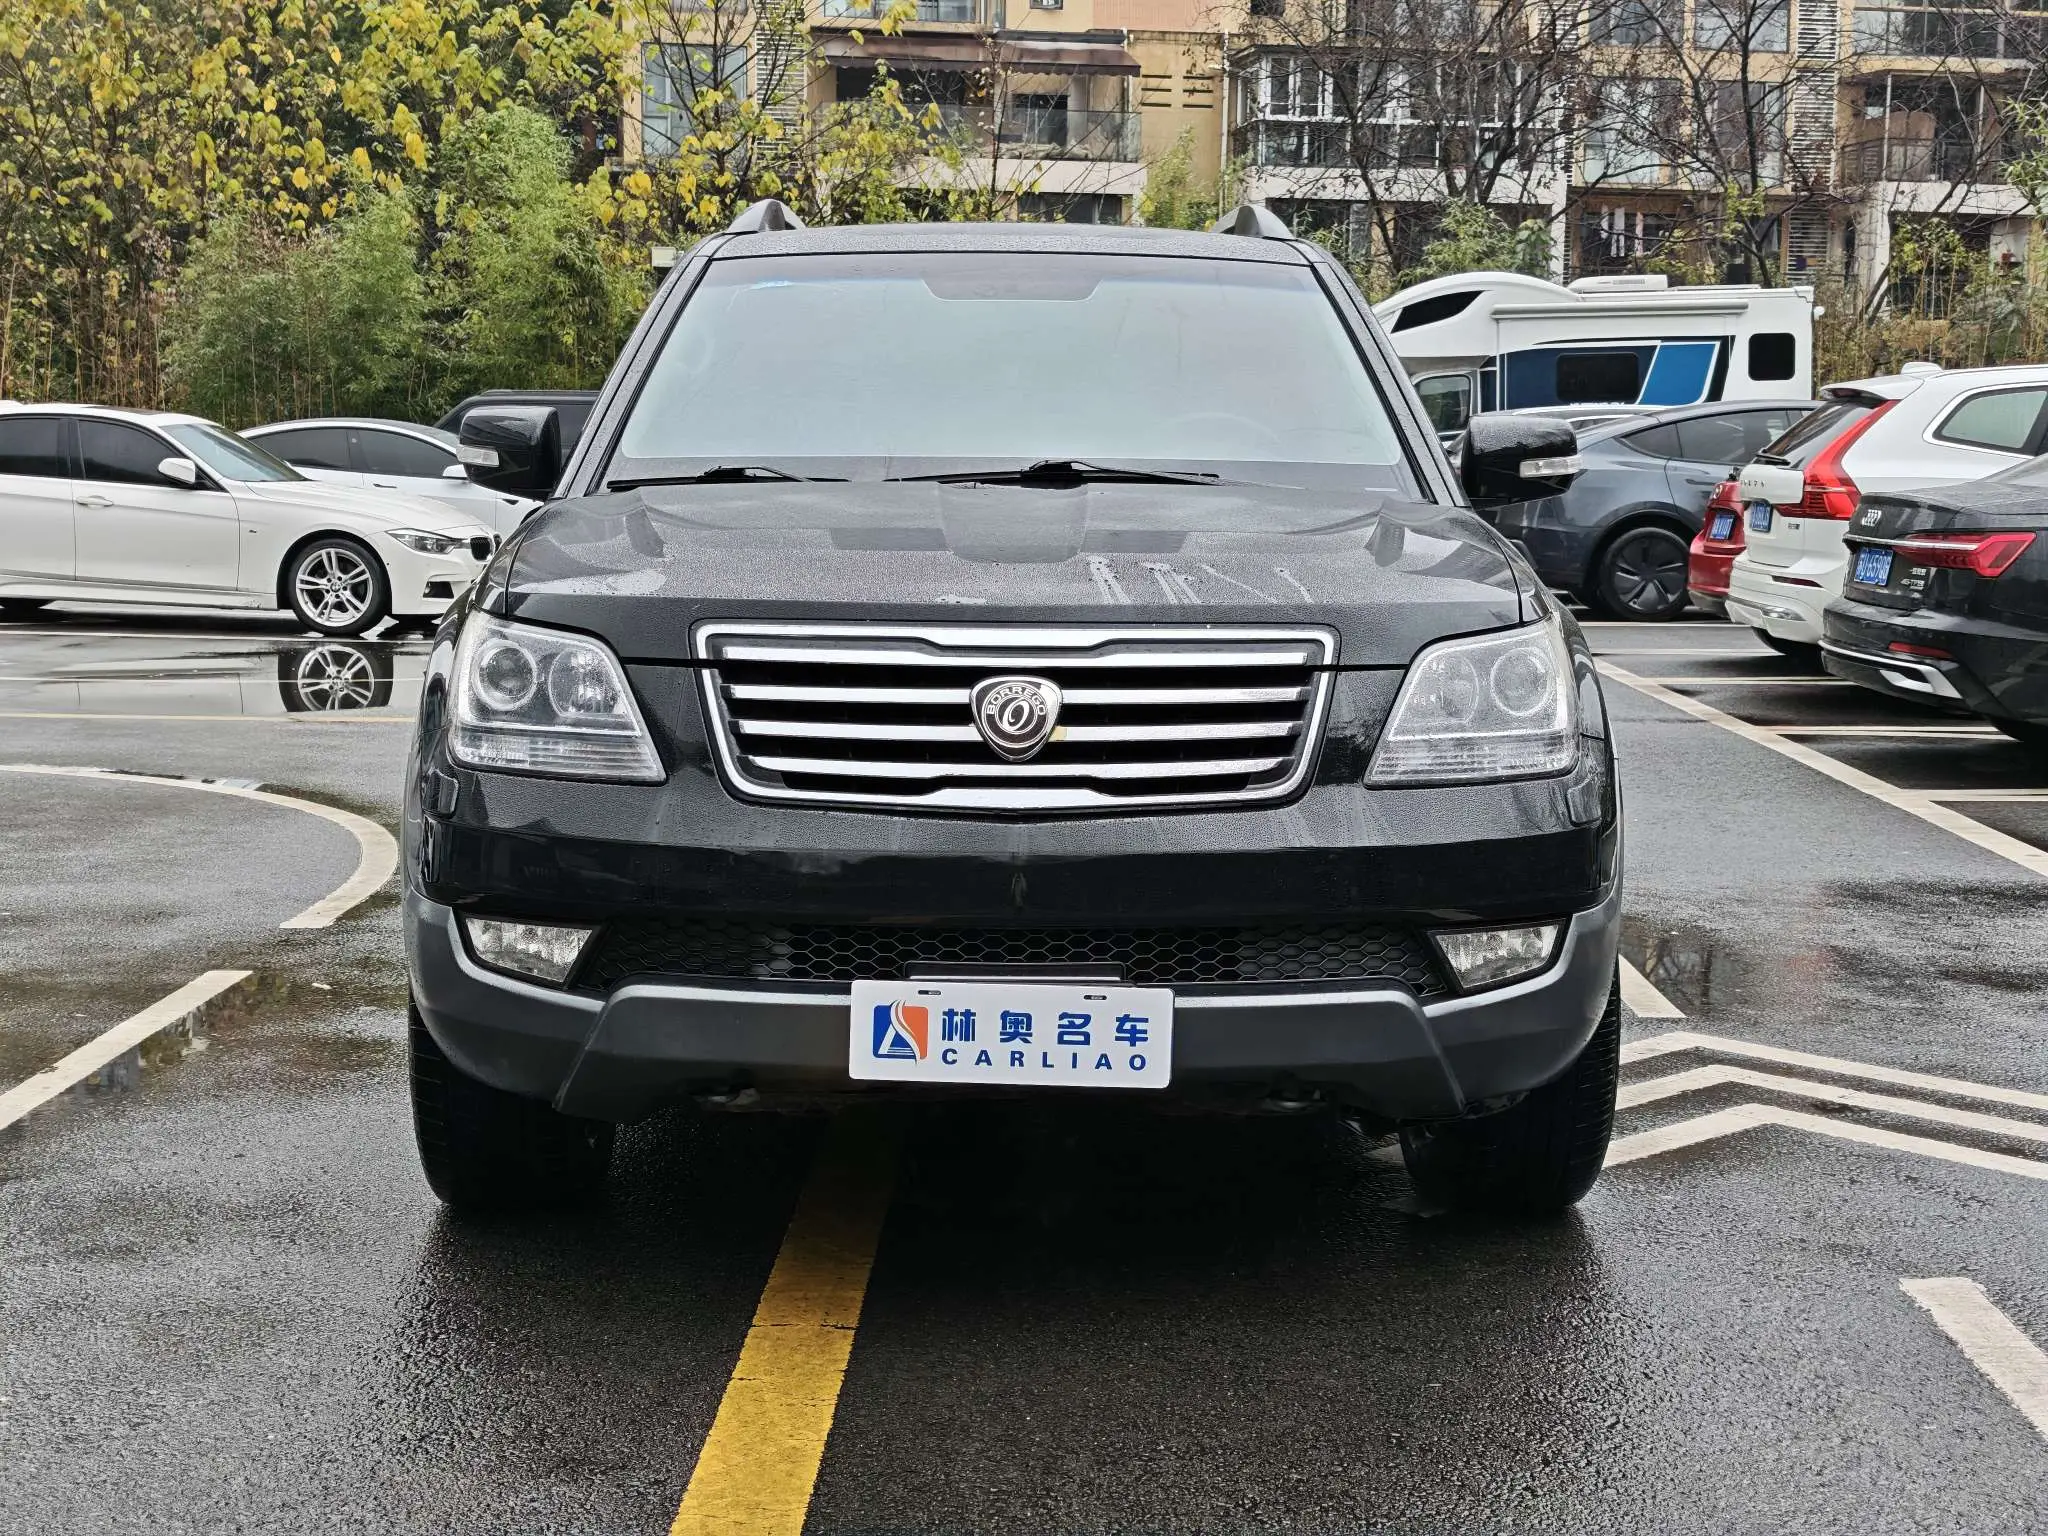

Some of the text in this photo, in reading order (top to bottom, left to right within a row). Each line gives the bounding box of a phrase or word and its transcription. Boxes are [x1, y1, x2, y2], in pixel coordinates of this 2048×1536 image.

[987, 686, 1046, 715] BORREGO
[941, 1007, 1150, 1048] 林奥名车
[941, 1047, 1148, 1072] CARLIAO
